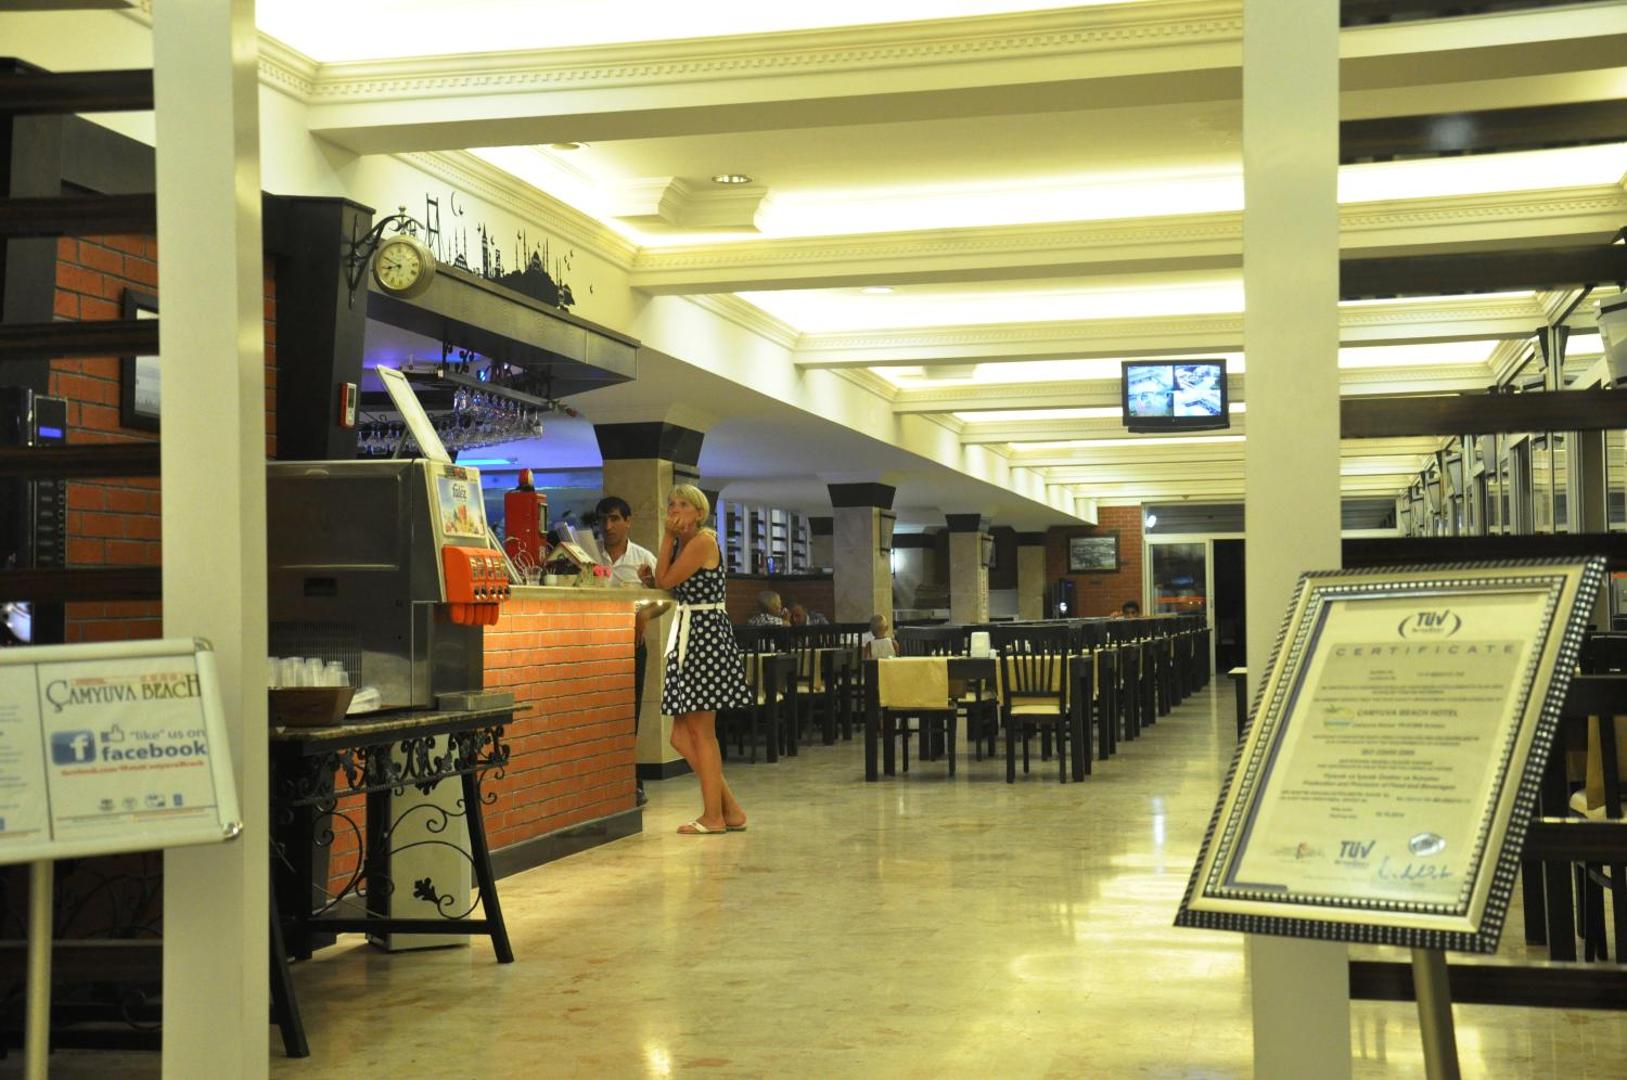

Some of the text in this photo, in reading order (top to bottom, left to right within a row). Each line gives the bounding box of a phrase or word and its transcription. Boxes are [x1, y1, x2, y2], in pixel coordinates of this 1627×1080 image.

[1335, 643, 1515, 657] CERTIFICATE
[141, 673, 202, 701] BEACH
[168, 730, 184, 739] us
[186, 728, 206, 738] on
[101, 740, 208, 762] facebook
[1339, 840, 1376, 859] TÜV
